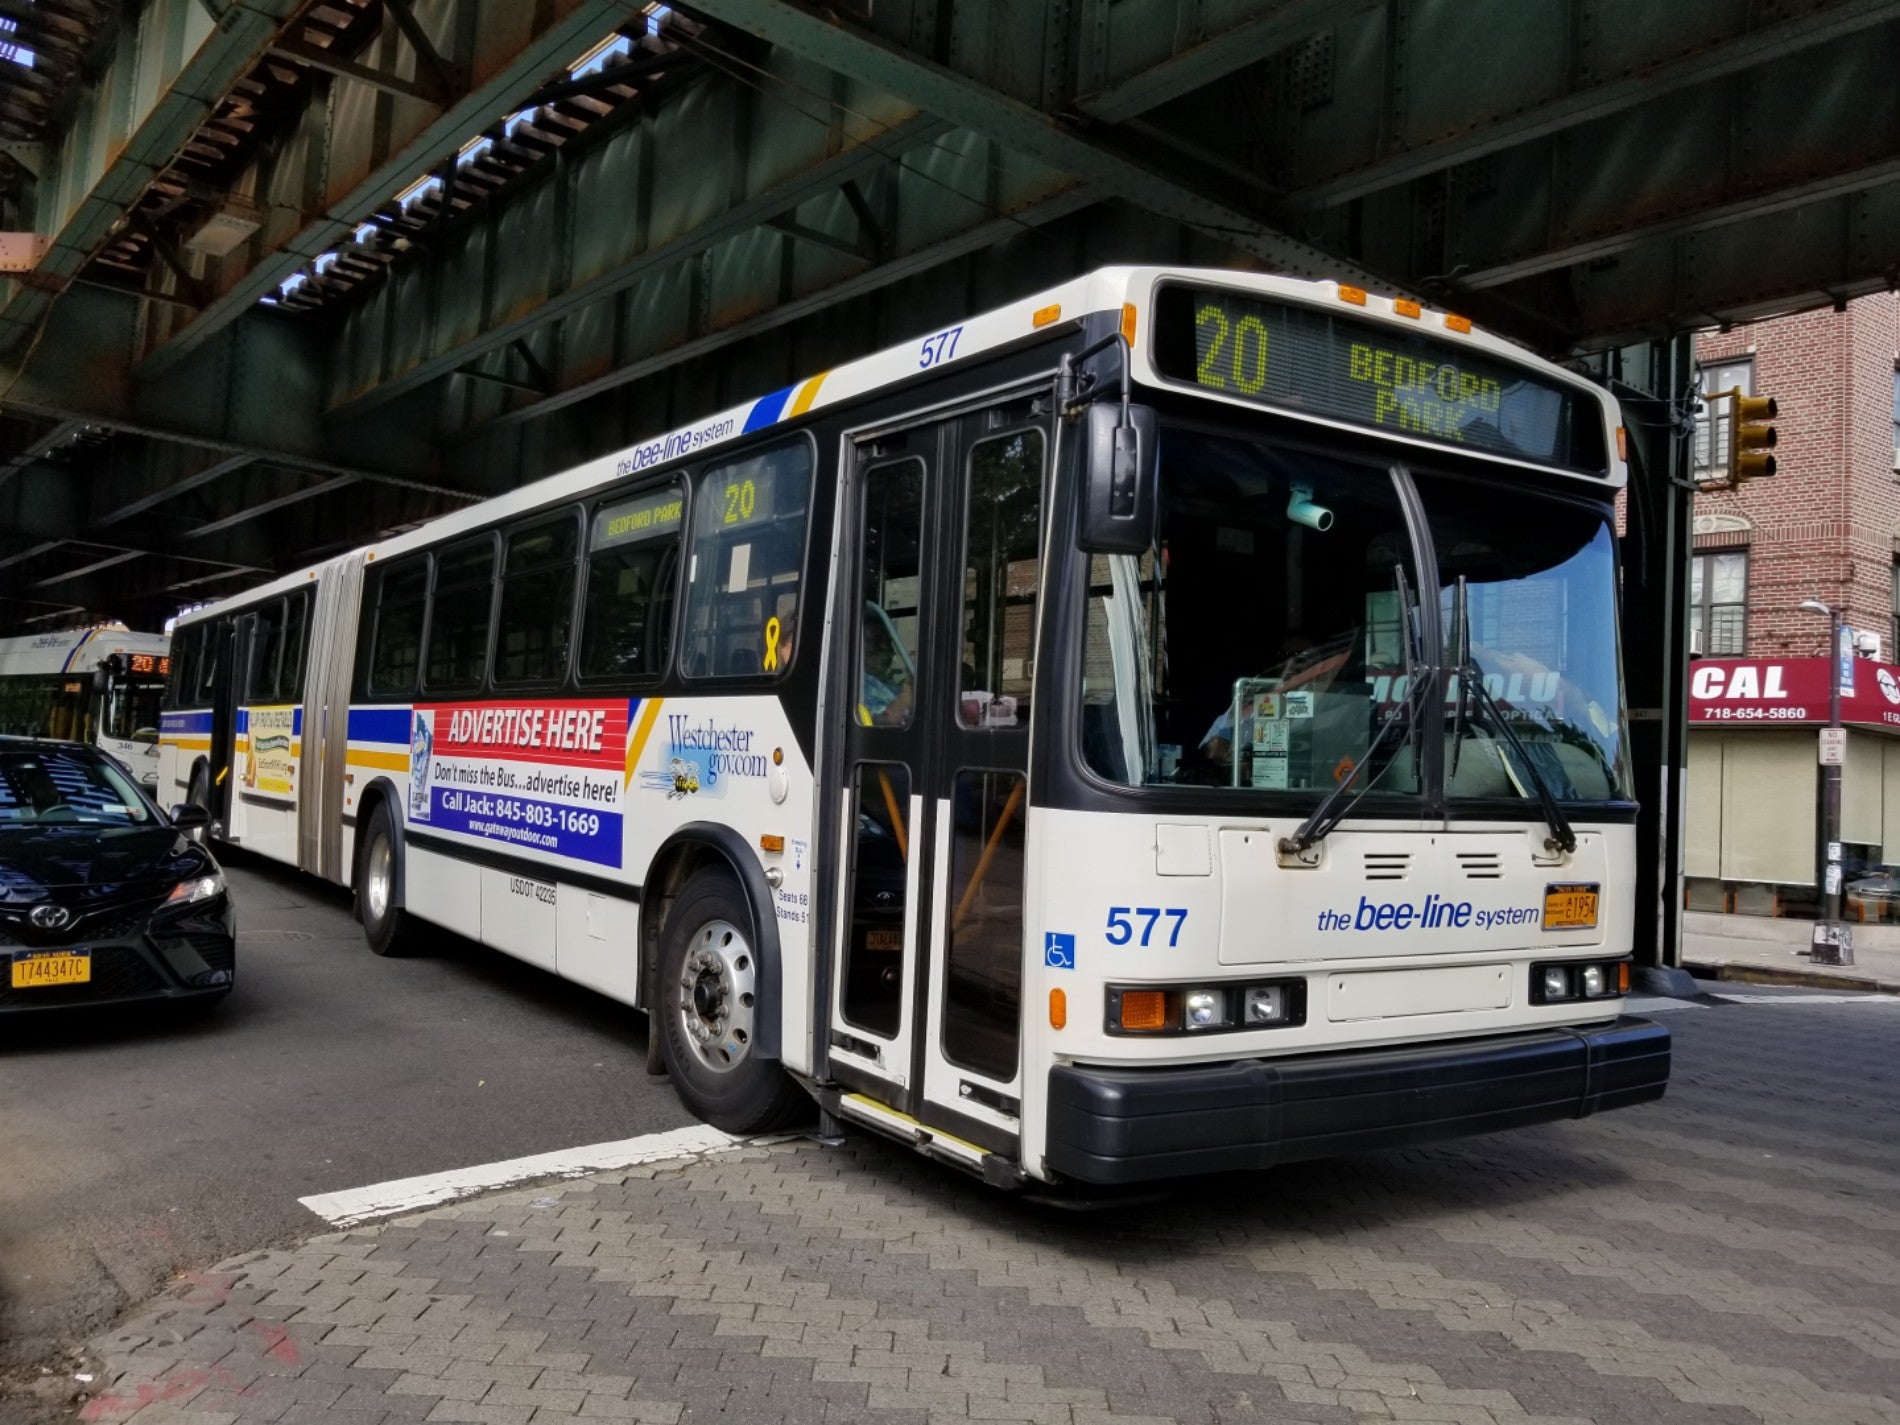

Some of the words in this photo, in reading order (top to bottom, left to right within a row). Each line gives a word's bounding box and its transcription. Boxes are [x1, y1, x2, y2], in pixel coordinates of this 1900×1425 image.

[919, 326, 963, 368] 577
[1196, 305, 1267, 395] 20
[1351, 343, 1500, 413] BEDFORD
[1376, 389, 1464, 442] PARK
[616, 460, 632, 477] the
[632, 429, 692, 471] bee-line
[692, 418, 734, 448] system
[608, 509, 654, 537] BEDFORD
[653, 502, 683, 525] PARK
[724, 480, 756, 524] 20
[131, 655, 153, 672] 20
[1692, 666, 1788, 699] CAL
[448, 709, 545, 748] ADVERTISE
[545, 709, 605, 751] HERE
[1704, 707, 1806, 719] 718-654-5860
[669, 714, 754, 754] Westchester
[434, 762, 457, 781] Don't
[459, 765, 478, 785] miss
[480, 765, 495, 786] the
[583, 776, 618, 803] here!
[707, 752, 767, 785] gov.com
[442, 791, 462, 811] Call
[464, 794, 494, 816] Jack:
[496, 799, 600, 836] 845-803-1669
[469, 819, 558, 848] www.gatewayoutdoor.com
[510, 877, 534, 899] USDOT
[778, 888, 798, 904] Seats
[776, 905, 800, 922] Stands
[1105, 906, 1188, 947] 577
[1317, 909, 1351, 931] the
[1354, 893, 1473, 932] bee-line
[1475, 907, 1540, 931] system
[20, 959, 82, 981] T744347C
